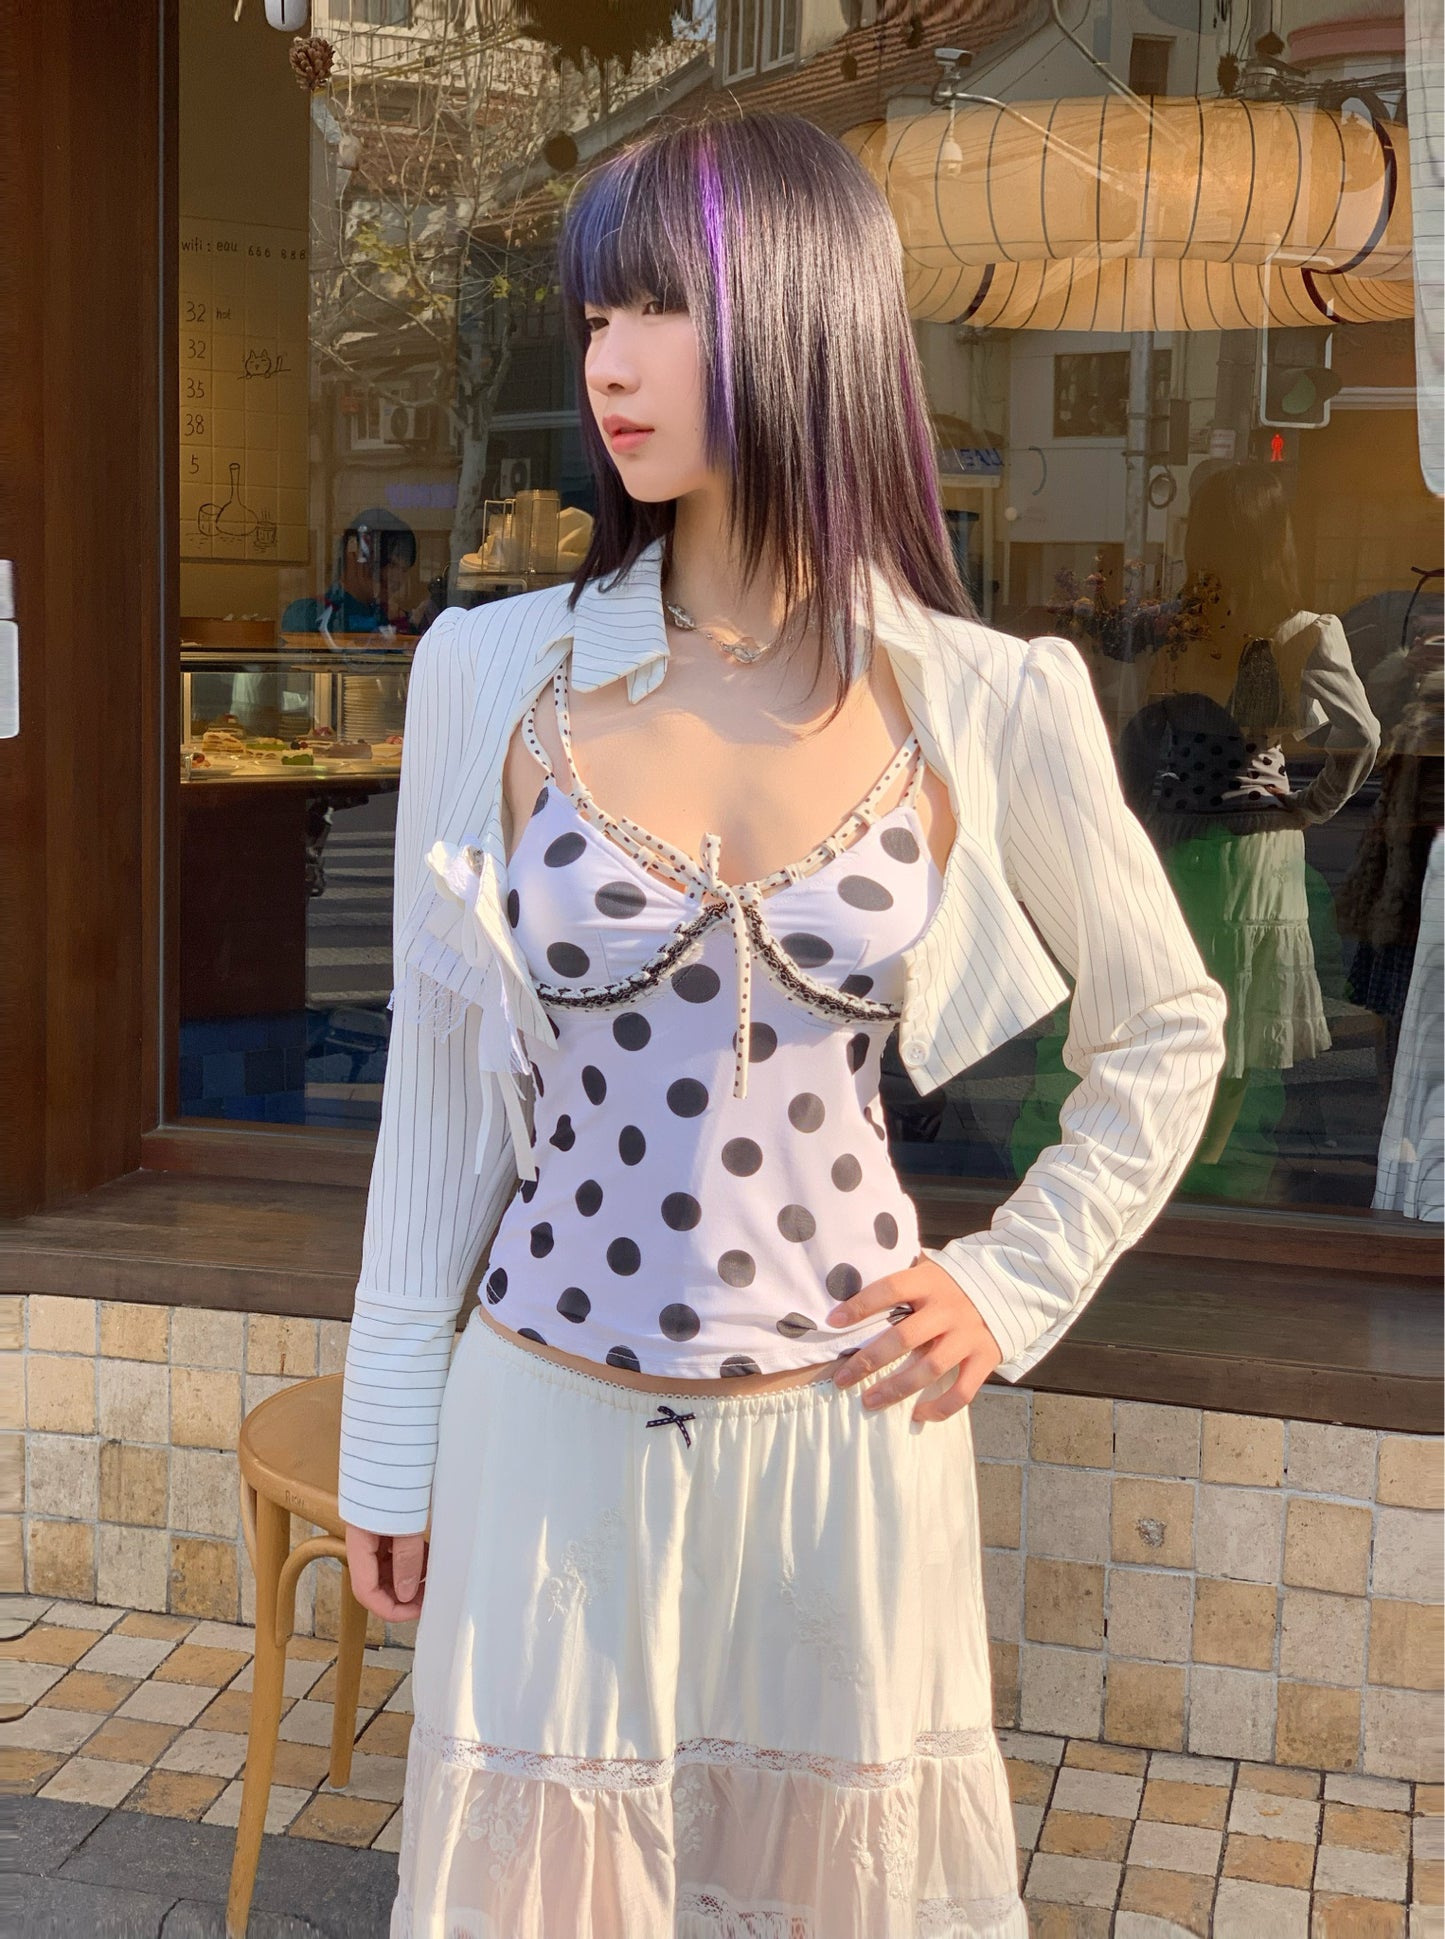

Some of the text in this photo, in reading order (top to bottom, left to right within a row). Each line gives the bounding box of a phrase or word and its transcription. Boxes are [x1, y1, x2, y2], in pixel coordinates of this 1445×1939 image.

[186, 301, 232, 322] 32 hot
[187, 339, 206, 359] 32
[186, 377, 205, 398] 35
[184, 413, 204, 436] 38
[189, 454, 199, 474] 5
